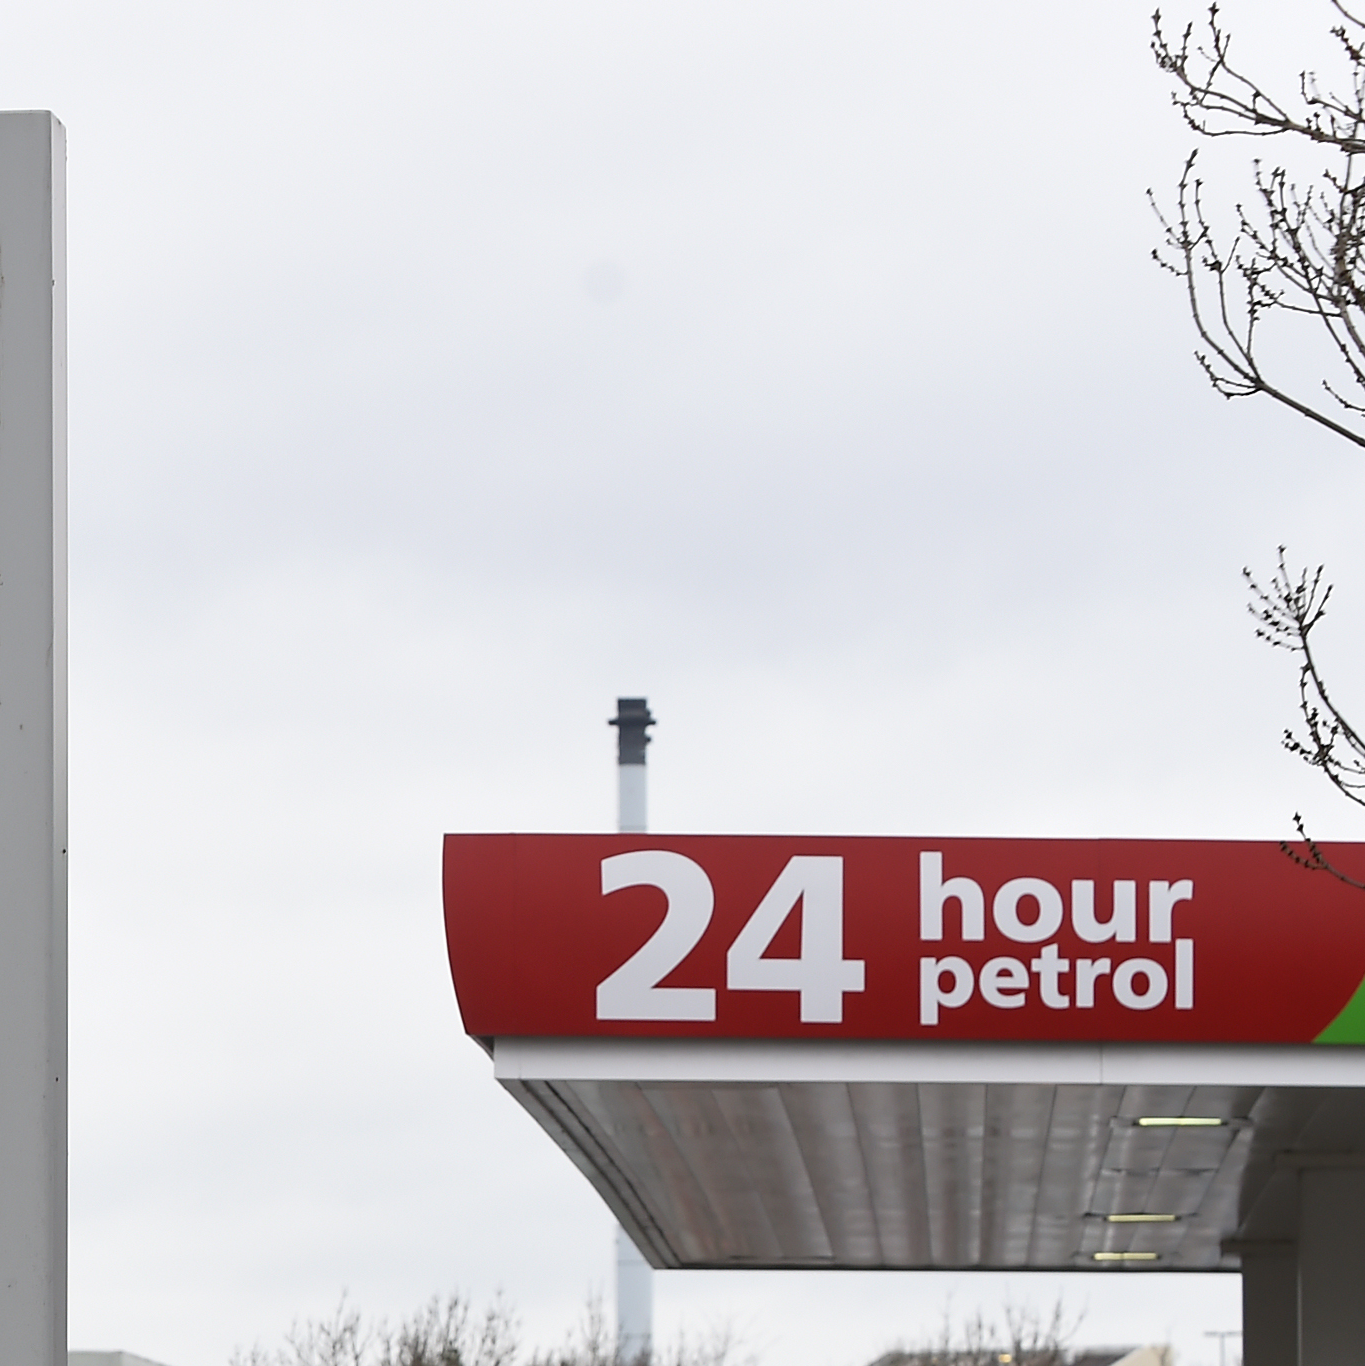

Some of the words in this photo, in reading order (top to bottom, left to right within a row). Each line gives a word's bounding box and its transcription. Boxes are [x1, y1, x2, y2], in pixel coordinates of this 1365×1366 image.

[595, 849, 865, 1023] 24
[919, 851, 1194, 943] hour
[919, 937, 1194, 1025] petrol
